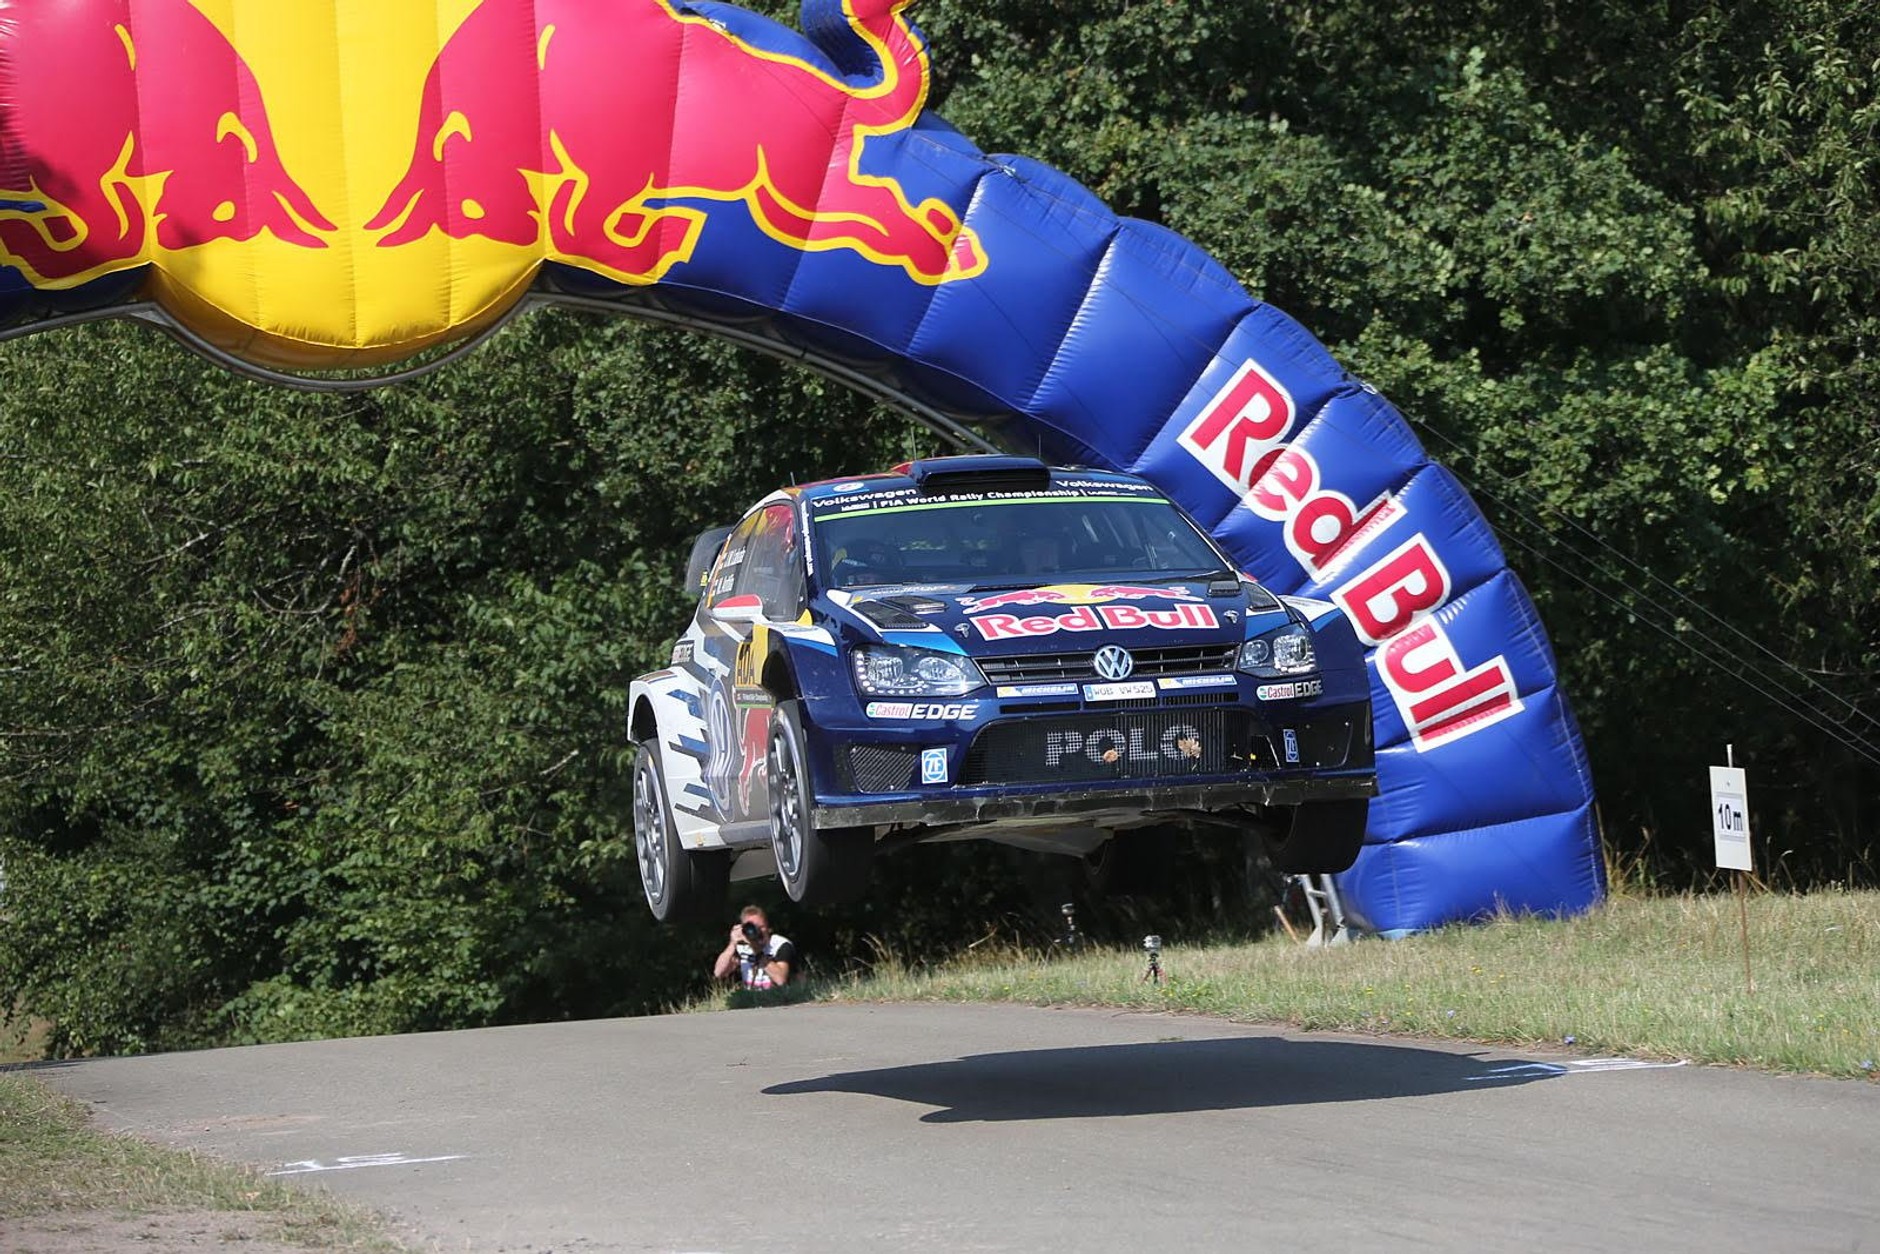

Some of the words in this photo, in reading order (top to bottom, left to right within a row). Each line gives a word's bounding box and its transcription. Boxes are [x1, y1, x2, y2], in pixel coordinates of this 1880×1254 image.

[1055, 480, 1154, 491] Volkswagen
[813, 488, 917, 508] Volkswagen
[881, 499, 903, 508] FIA
[906, 495, 946, 505] World
[950, 493, 984, 501] Rally
[987, 489, 1079, 499] Championship
[1180, 362, 1402, 580] Red
[1334, 536, 1520, 748] Bull
[971, 606, 1101, 640] Red
[1105, 602, 1219, 629] Bull
[1267, 685, 1294, 698] Castrol
[1295, 680, 1324, 698] EDGE
[875, 704, 910, 717] Castrol
[911, 703, 980, 720] EDGE
[1046, 724, 1201, 766] POLO
